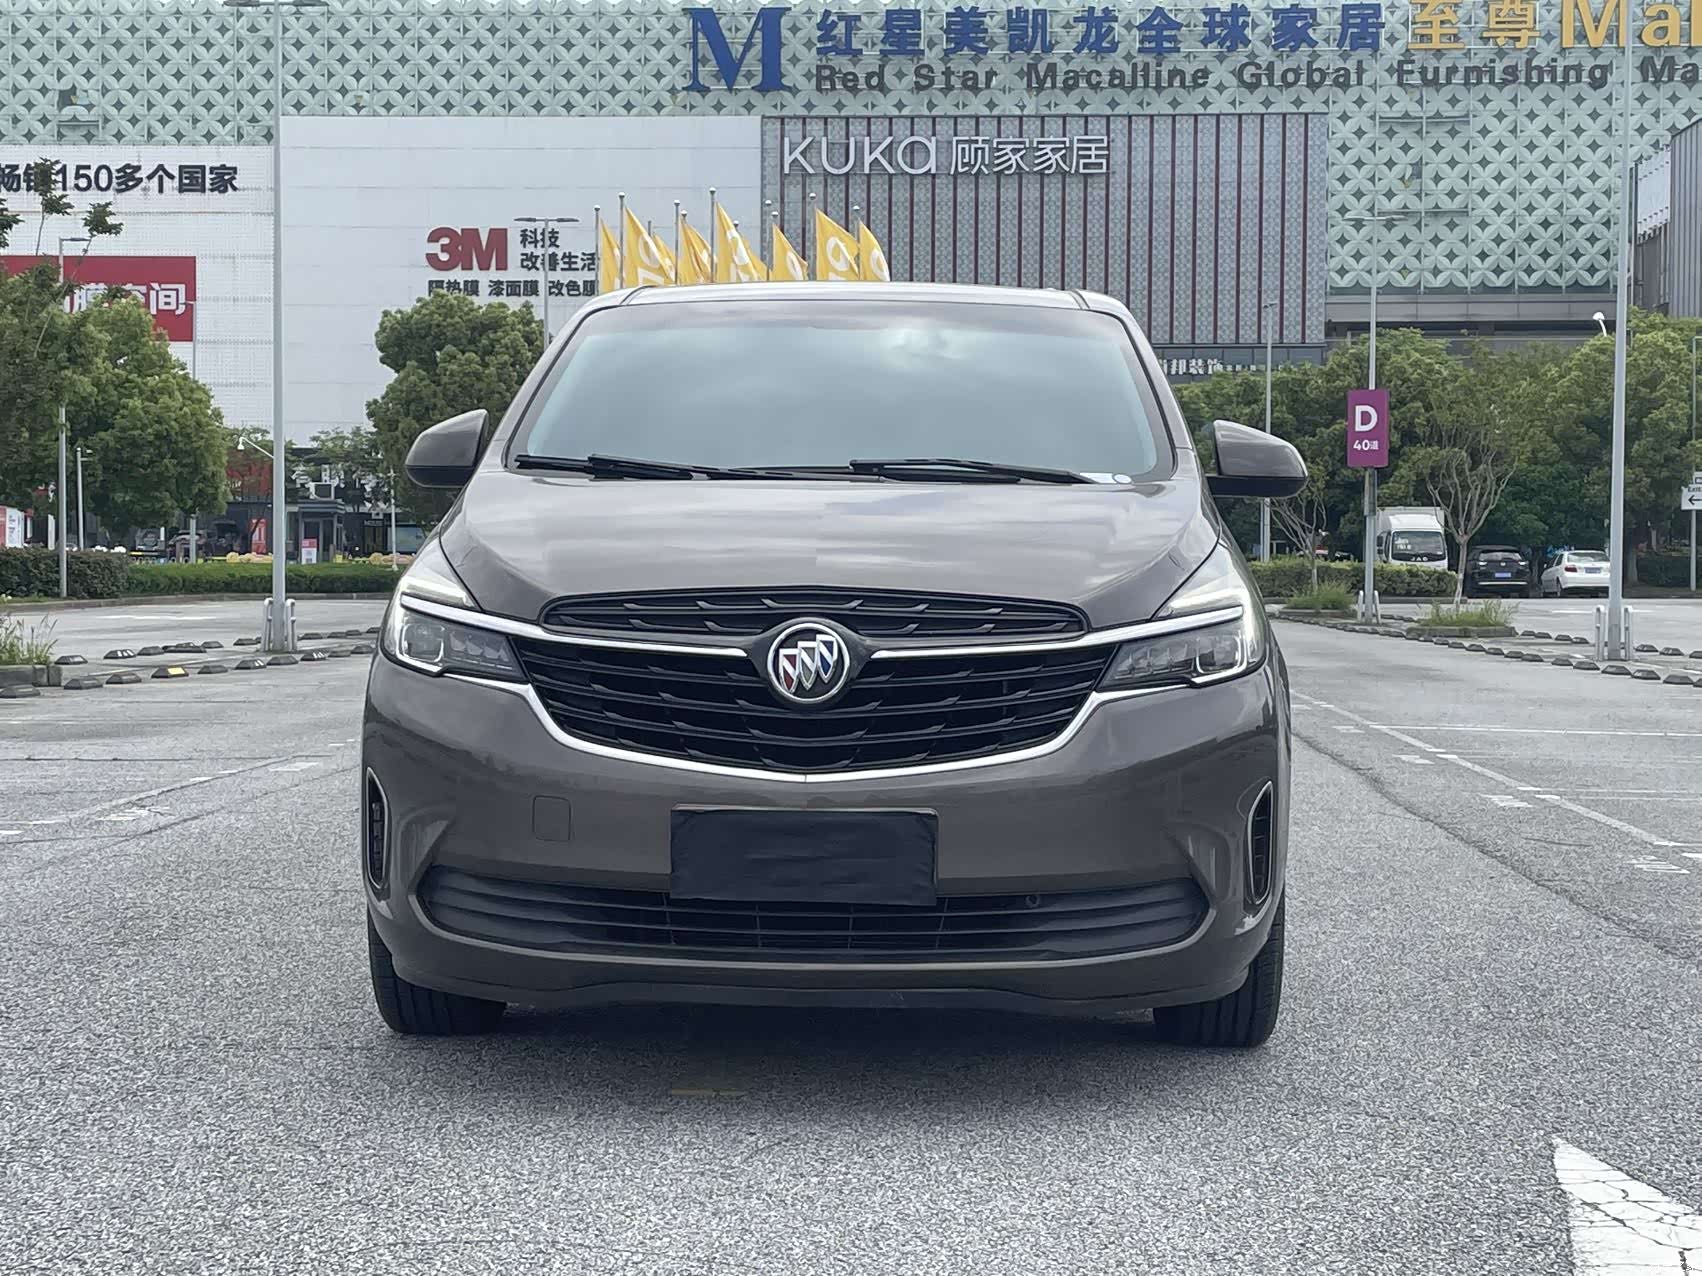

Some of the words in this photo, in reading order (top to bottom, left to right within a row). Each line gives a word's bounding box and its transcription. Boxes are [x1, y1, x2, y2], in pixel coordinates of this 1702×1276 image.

[815, 3, 1385, 56] 红星美凯龙全球家居
[1407, 0, 1540, 49] 至尊
[682, 6, 792, 92] M
[815, 62, 885, 92] Red
[914, 63, 997, 91] Star
[1026, 62, 1210, 91] Macalline
[1236, 60, 1365, 90] Global
[1396, 58, 1610, 91] Furnishing
[949, 135, 1110, 176] 顾家家居
[425, 226, 509, 272] 3M
[519, 228, 560, 248] 科技
[519, 252, 598, 272] 改善生活
[1354, 404, 1378, 432] D
